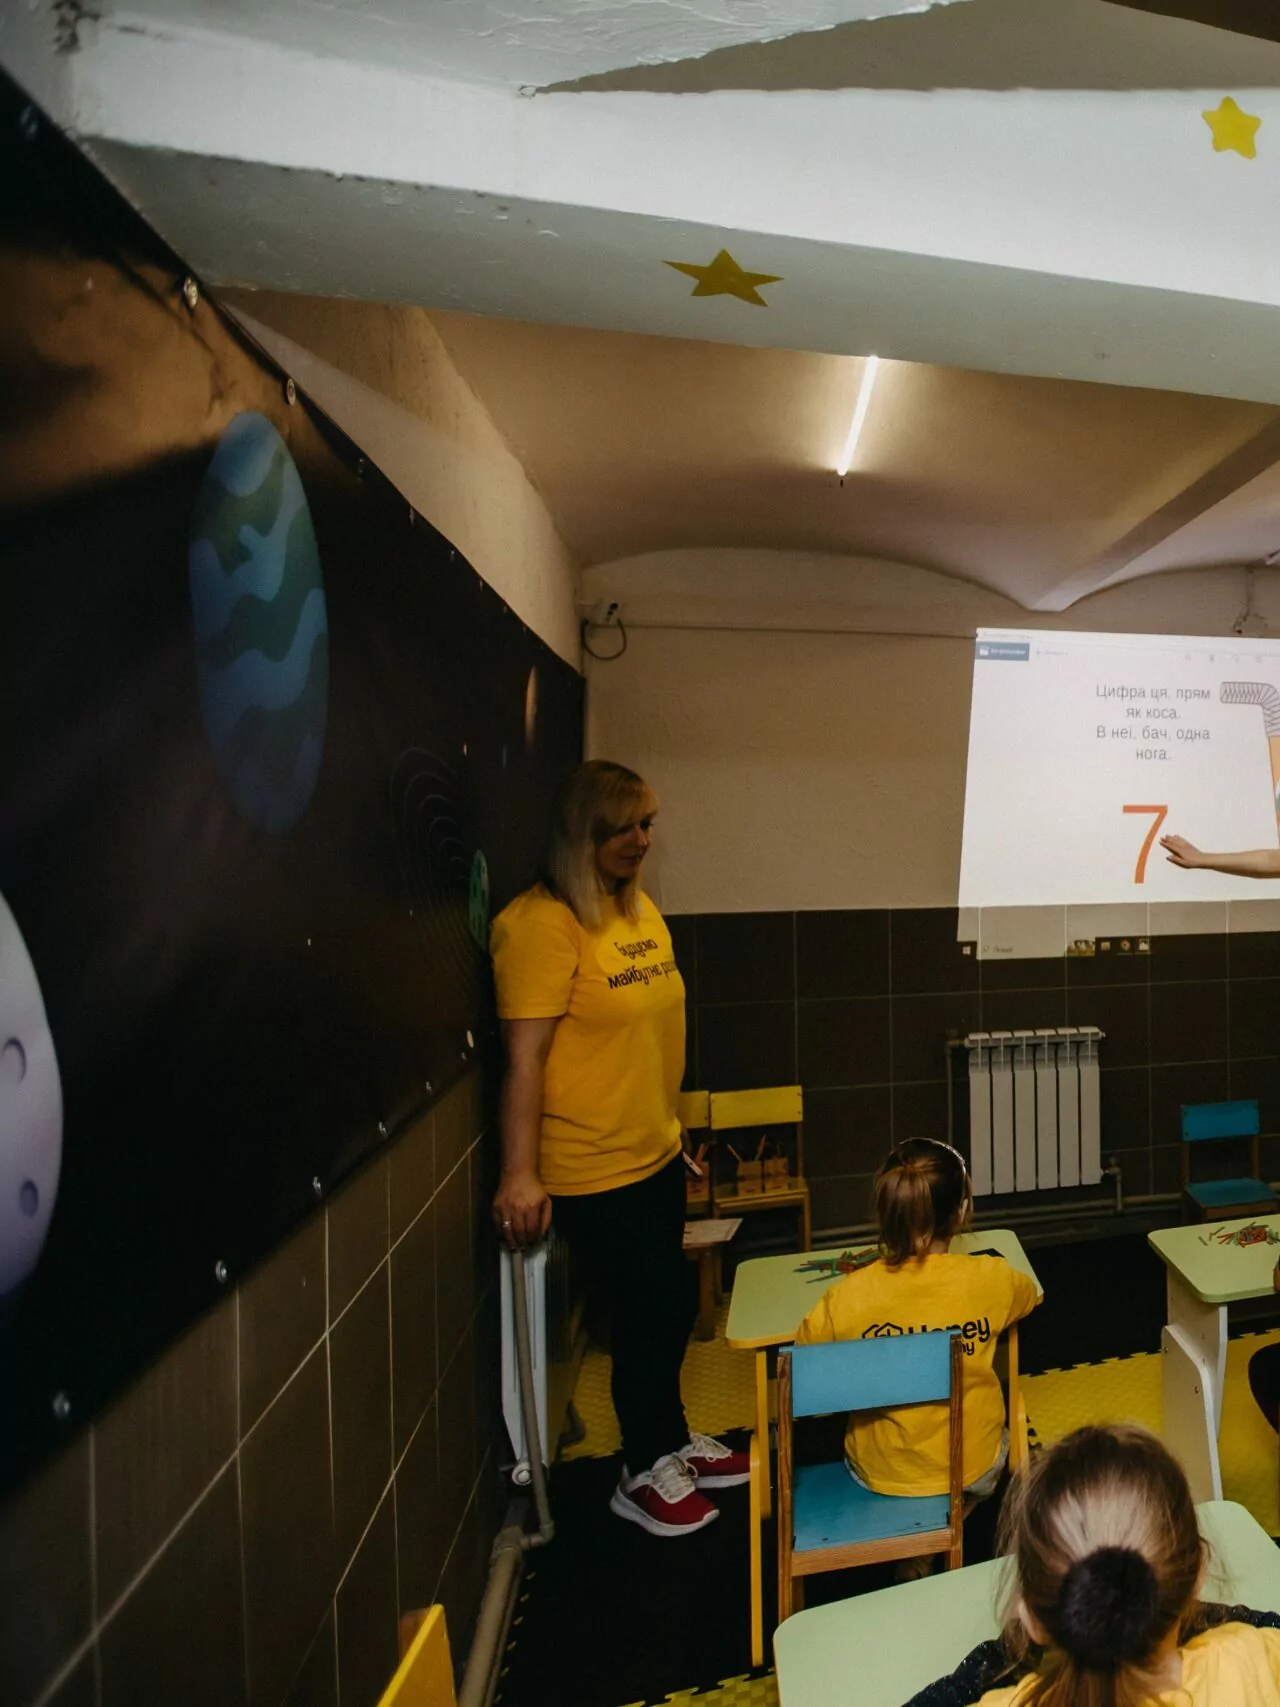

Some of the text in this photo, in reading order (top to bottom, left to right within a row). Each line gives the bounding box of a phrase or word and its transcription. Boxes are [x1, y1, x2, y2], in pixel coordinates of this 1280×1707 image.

[1096, 684, 1211, 701] Цифра ця, прям
[1126, 707, 1181, 720] як коса.
[1096, 725, 1106, 739] В
[1142, 726, 1171, 741] бач,
[1176, 728, 1210, 742] одна
[1136, 748, 1172, 760] нога.
[1122, 805, 1168, 884] 7
